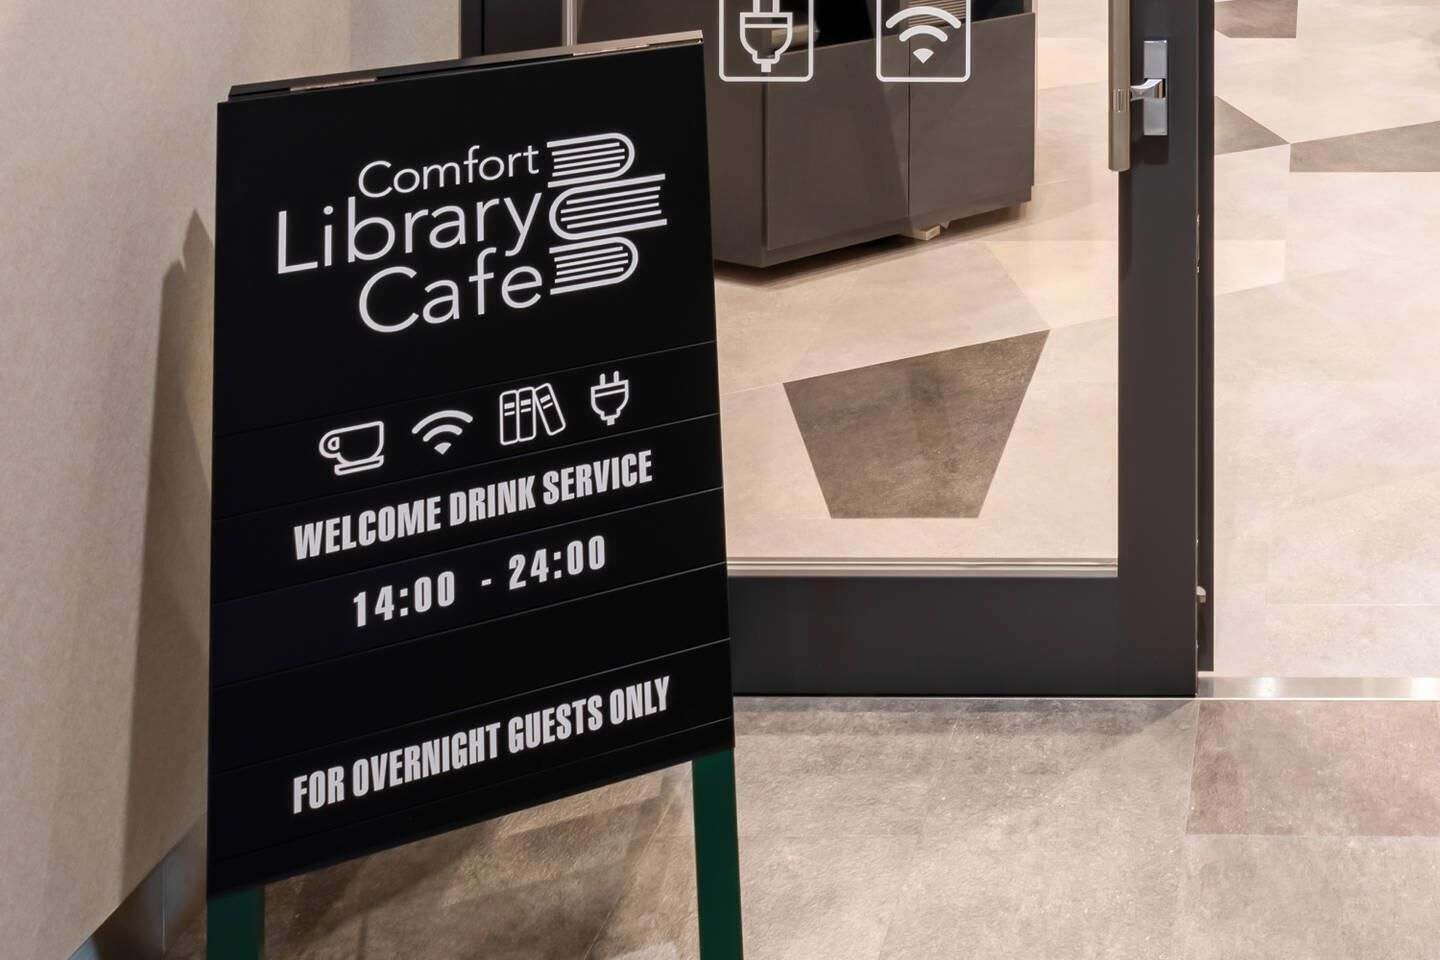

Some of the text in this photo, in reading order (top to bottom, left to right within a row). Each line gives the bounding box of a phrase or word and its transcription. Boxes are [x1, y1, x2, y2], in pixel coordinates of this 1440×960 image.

[358, 145, 540, 198] Comfort
[277, 192, 542, 274] Library
[358, 247, 543, 333] Cafe
[294, 450, 653, 560] WELCOME DRINK SERVICE
[353, 571, 455, 628] 14:00
[509, 535, 606, 590] 24:00
[293, 675, 670, 814] FOR OVERNIGHT GUESTS ONLY
